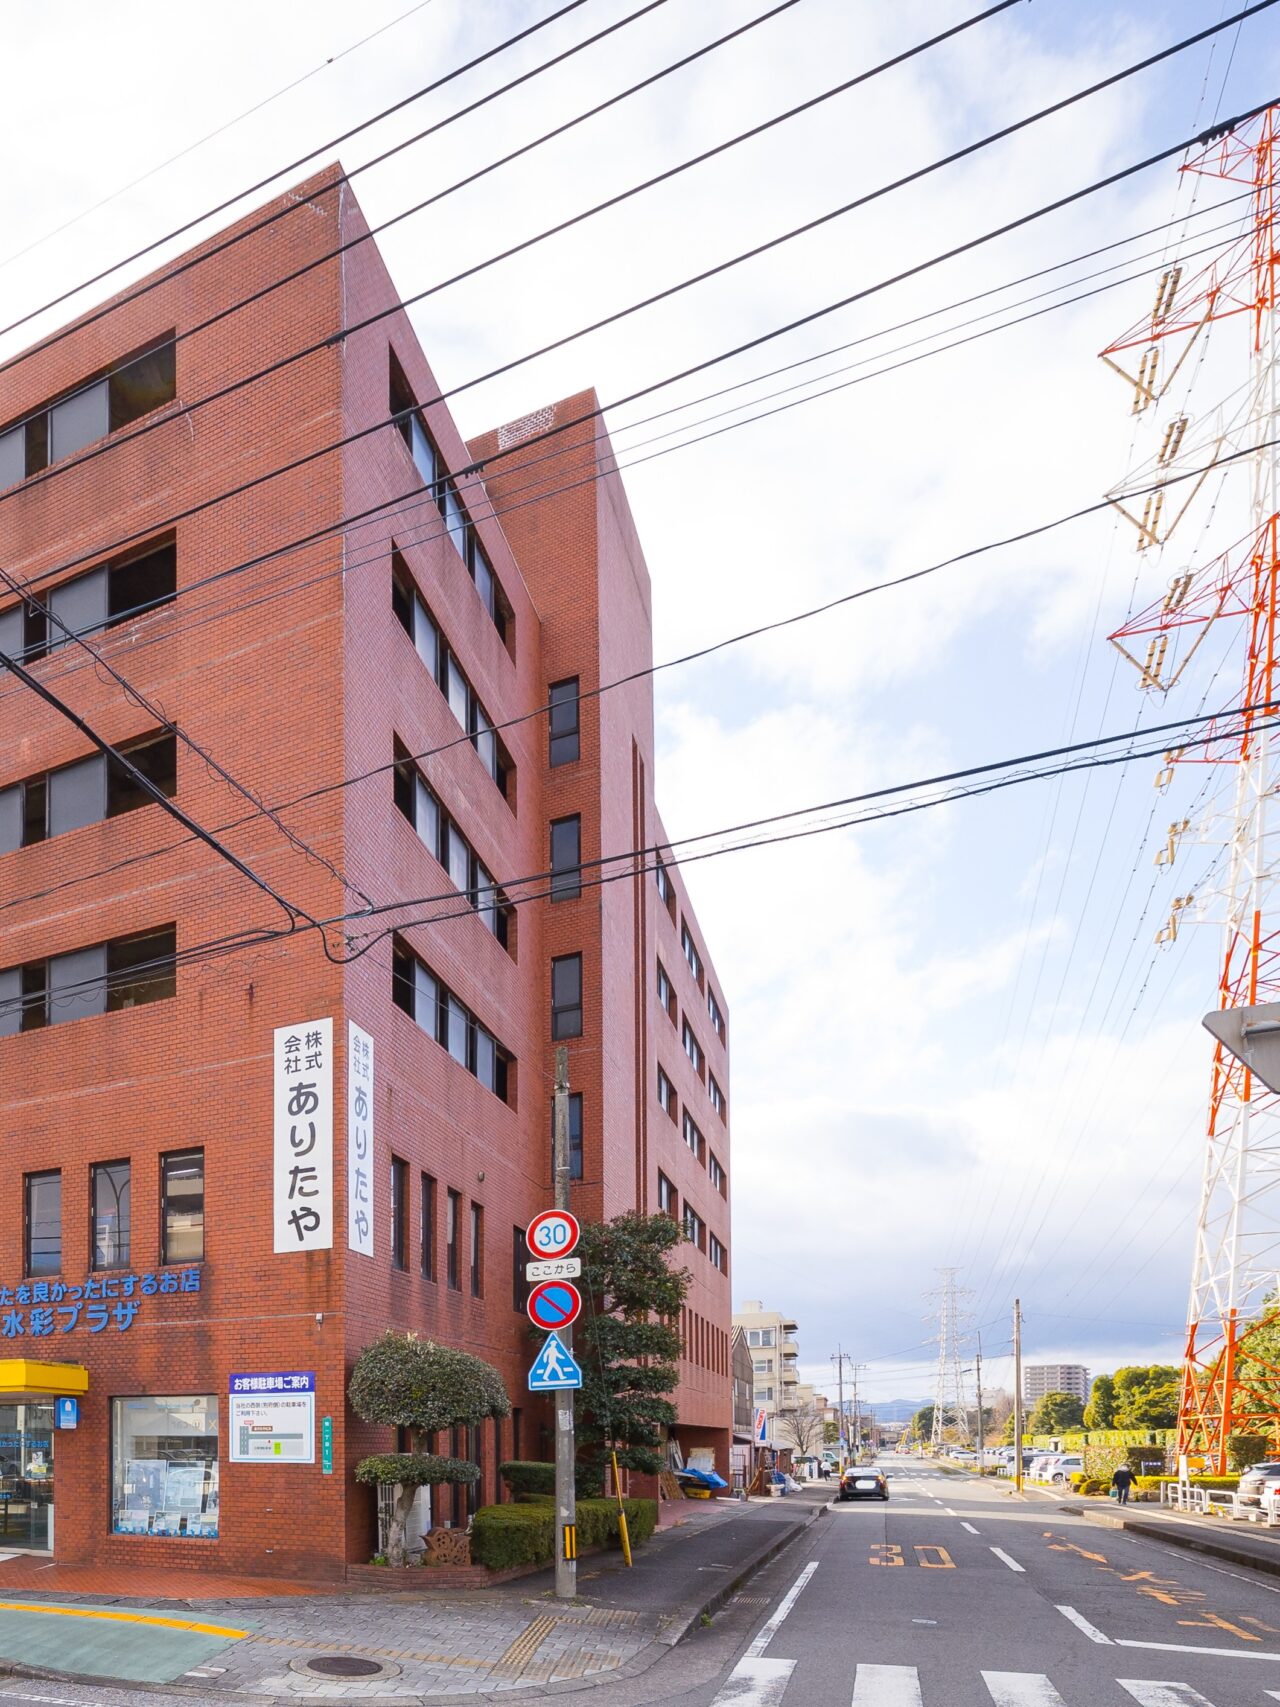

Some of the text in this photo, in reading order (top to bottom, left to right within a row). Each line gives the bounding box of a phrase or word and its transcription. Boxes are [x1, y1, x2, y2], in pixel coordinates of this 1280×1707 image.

[287, 1082, 321, 1242] ありたや
[354, 1085, 369, 1244] ありたや
[539, 1224, 567, 1247] 30
[531, 1263, 576, 1277] ここから
[234, 1376, 309, 1391] お客様駐車場ご案内
[869, 1544, 957, 1569] 30
